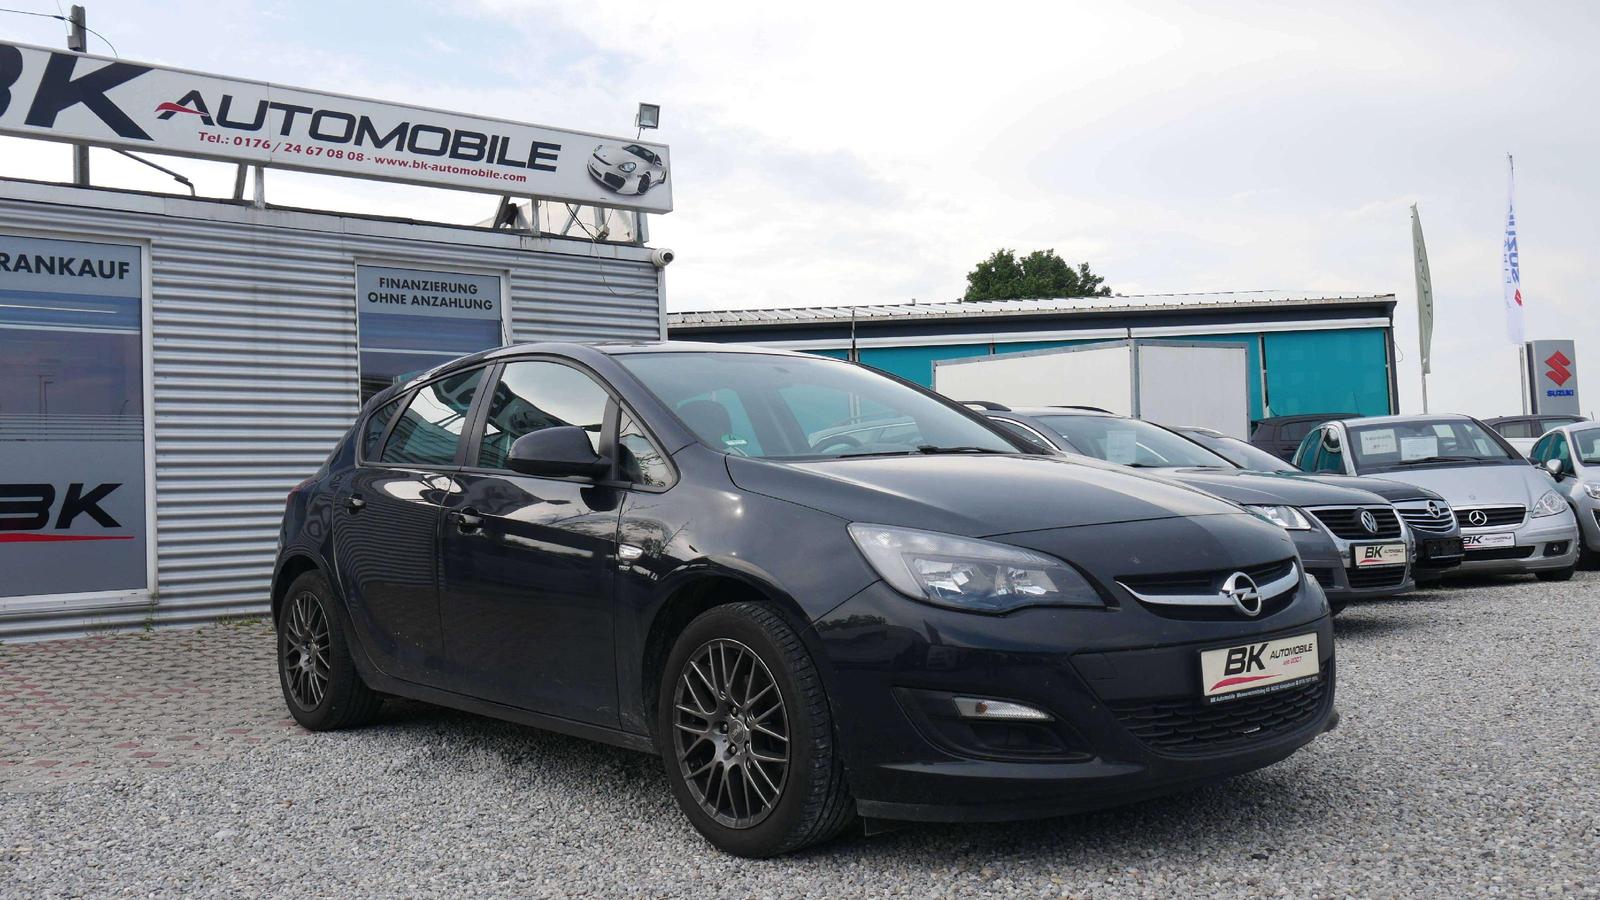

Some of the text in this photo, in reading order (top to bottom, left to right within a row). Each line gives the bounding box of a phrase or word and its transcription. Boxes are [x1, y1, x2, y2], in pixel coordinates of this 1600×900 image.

[155, 89, 561, 172] AUTOMOBILE
[198, 131, 229, 144] Tel.:
[233, 136, 271, 149] 0176
[284, 143, 302, 154] 24
[306, 146, 323, 156] 67
[327, 149, 343, 159] 08
[347, 152, 364, 161] 08
[374, 156, 527, 182] www.bk-automobile.com
[379, 277, 478, 295] FINANZIERUNG
[367, 291, 493, 311] OHNE ANZAHLUNG
[1546, 389, 1574, 397] SUZUKI
[1365, 546, 1384, 558] BK
[1224, 643, 1313, 676] BK AUTOMOBILE
